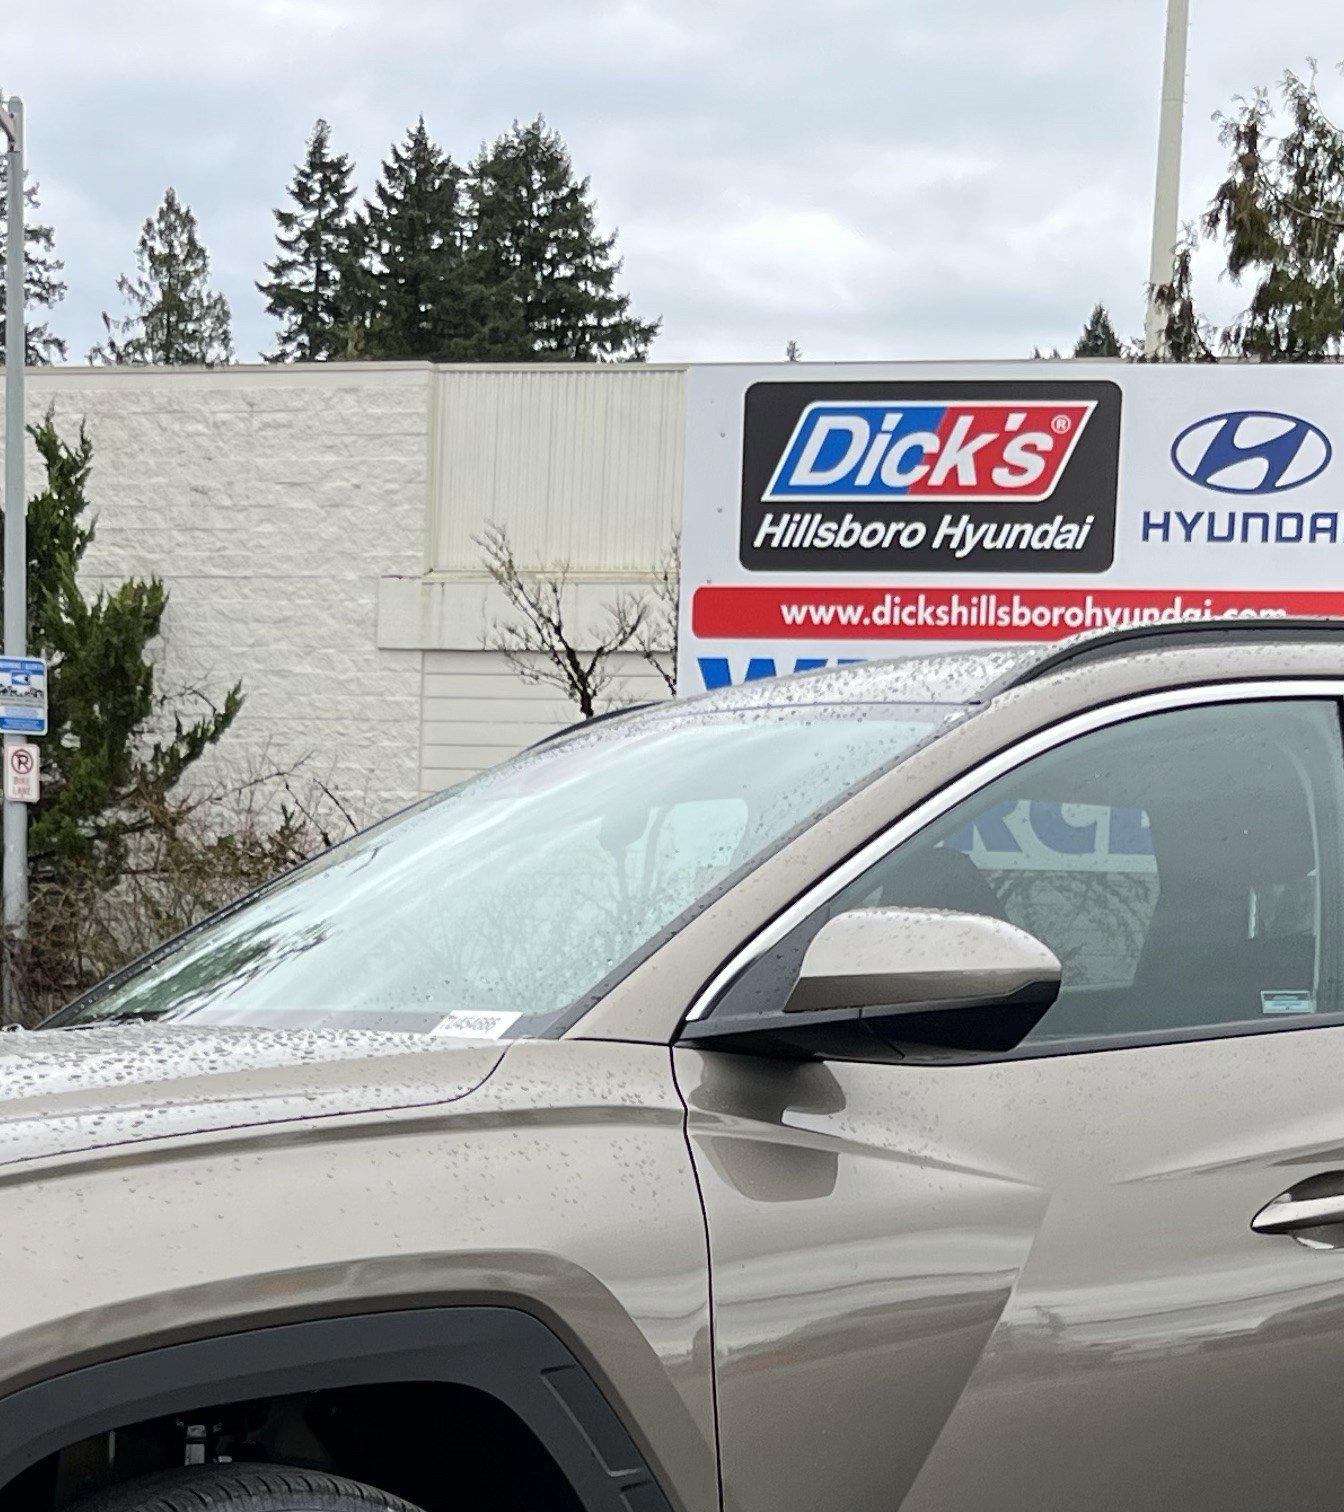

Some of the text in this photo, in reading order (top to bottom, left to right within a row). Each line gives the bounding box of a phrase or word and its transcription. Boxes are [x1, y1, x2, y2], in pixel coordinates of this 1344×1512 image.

[788, 412, 1054, 488] Dick's
[753, 513, 1096, 558] Hillsboro Hyundai
